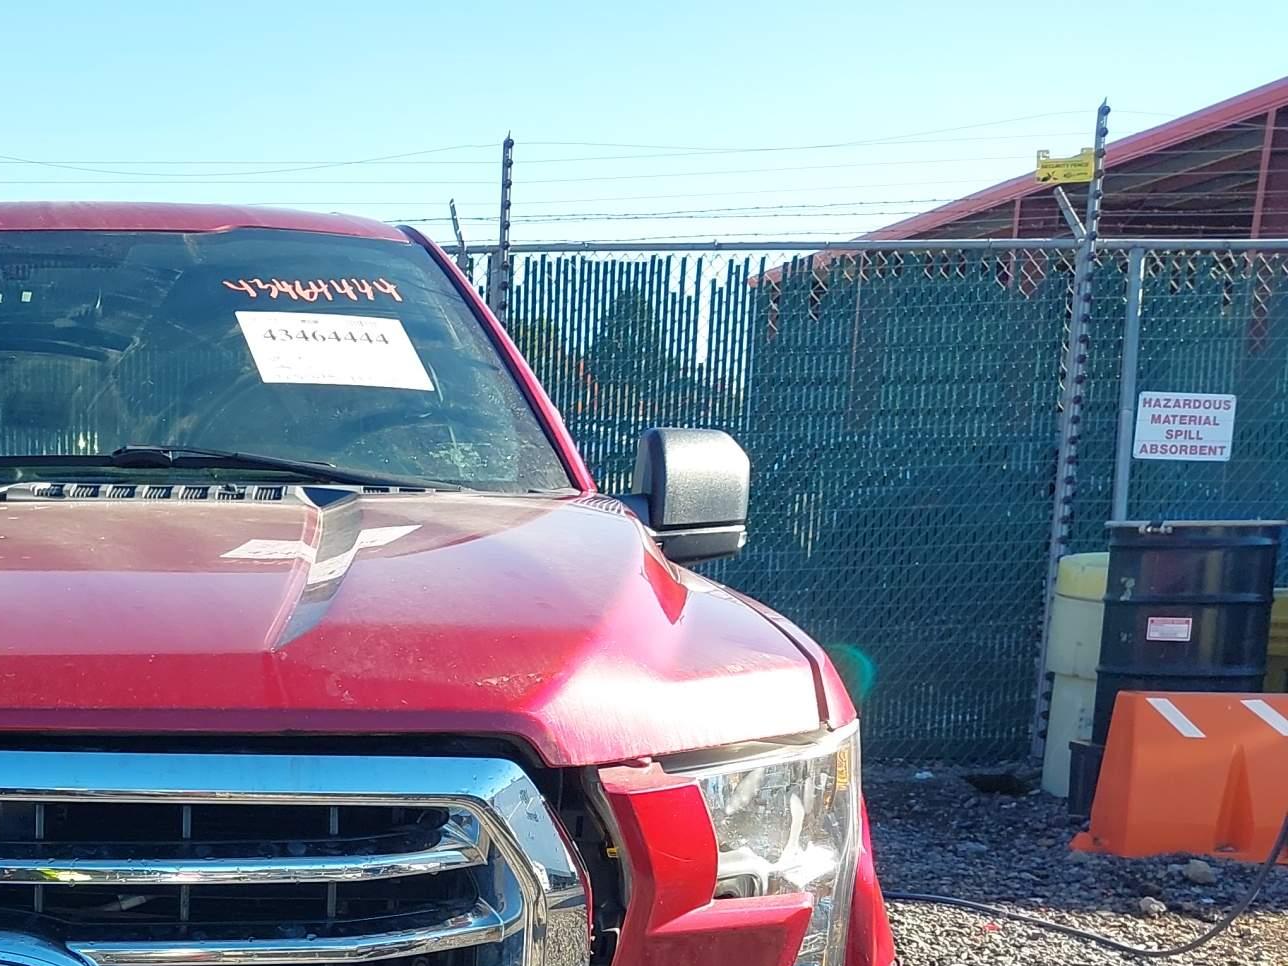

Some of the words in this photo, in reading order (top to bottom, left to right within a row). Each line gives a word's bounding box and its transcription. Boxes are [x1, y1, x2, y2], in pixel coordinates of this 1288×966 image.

[223, 278, 402, 302] 43464444
[263, 328, 389, 345] 43464444
[1142, 397, 1232, 411] HAZARDOUS
[1150, 414, 1220, 426] MATERIAL
[1165, 429, 1203, 441] SPILL
[1139, 443, 1227, 456] ABSORBENT
